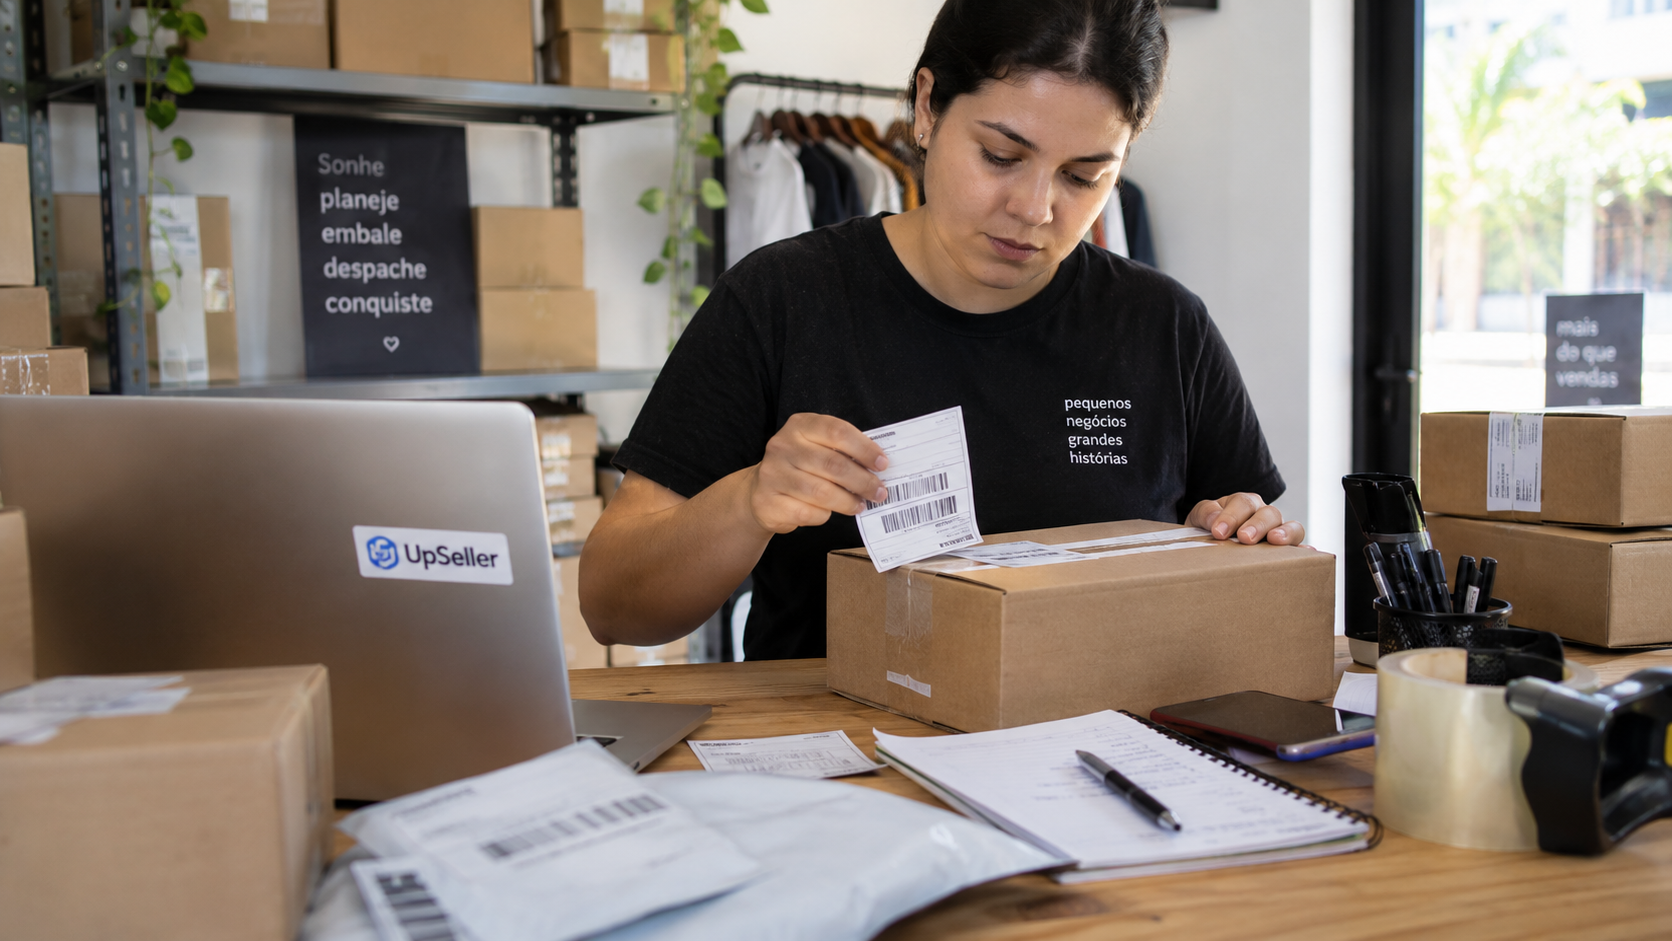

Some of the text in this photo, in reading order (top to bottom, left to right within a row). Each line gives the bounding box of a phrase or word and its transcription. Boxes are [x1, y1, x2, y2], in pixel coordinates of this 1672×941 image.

[318, 153, 385, 177] Sonhe
[320, 187, 400, 216] planeje
[321, 222, 403, 245] embale
[323, 256, 428, 284] despache
[325, 291, 433, 319] conquiste
[1556, 316, 1600, 337] mais
[1555, 340, 1617, 366] do que
[1555, 366, 1619, 388] vendas
[1064, 399, 1132, 412] pequenos
[1066, 414, 1127, 430] negócios
[1068, 433, 1123, 448] grandes
[1069, 451, 1128, 464] histórias
[404, 544, 499, 570] UpSeller
